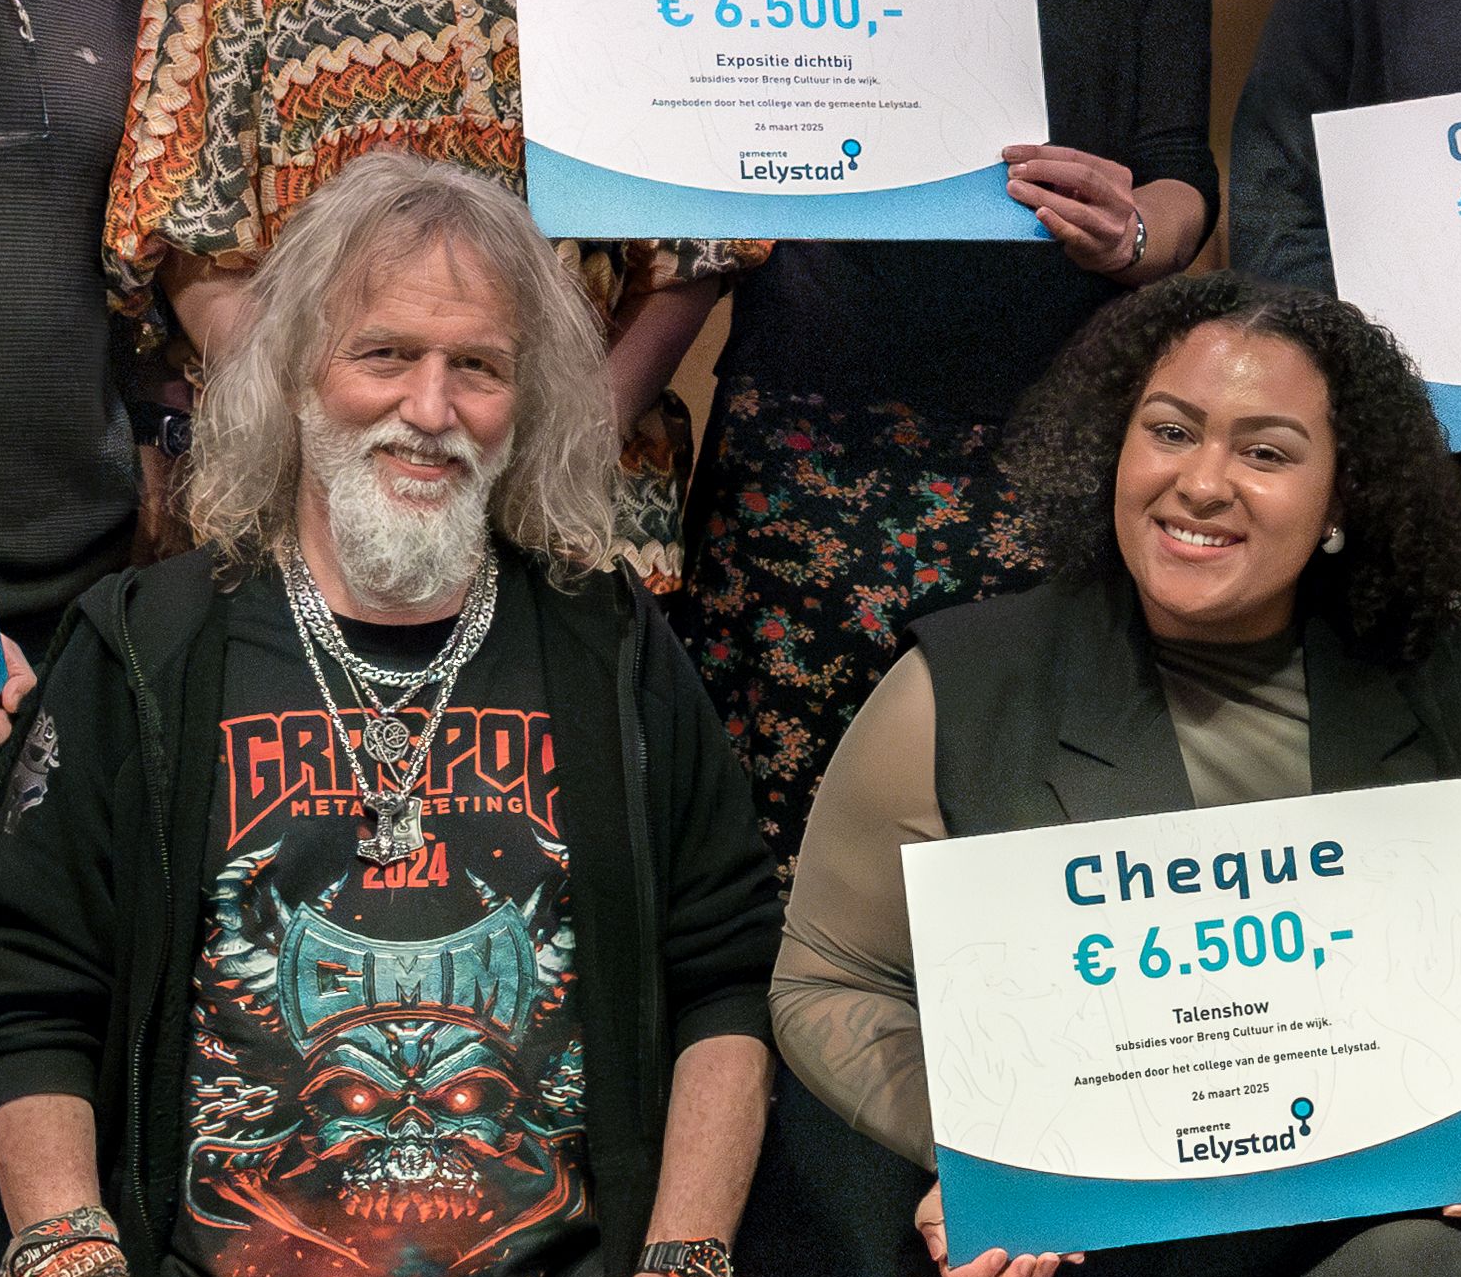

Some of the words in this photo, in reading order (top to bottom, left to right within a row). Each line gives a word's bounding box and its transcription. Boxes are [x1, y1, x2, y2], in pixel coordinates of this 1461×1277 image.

[716, 53, 790, 70] Expositie
[793, 54, 853, 72] dichtbij
[754, 122, 767, 132] 26
[768, 123, 799, 132] maart
[800, 122, 825, 132] 2025
[738, 150, 788, 160] gemeente
[739, 159, 845, 185] Lelystad
[291, 798, 364, 817] META
[420, 796, 524, 816] EETING
[1064, 840, 1345, 907] Cheque
[1071, 933, 1117, 987] €
[1138, 910, 1354, 980] 6.500,-
[1171, 1001, 1270, 1025] Talenshow
[1115, 1037, 1168, 1052] subsidies
[1168, 1034, 1195, 1045] voor
[1196, 1030, 1231, 1043] Breng
[1232, 1024, 1275, 1038] Cultuur
[1276, 1022, 1288, 1033] in
[1289, 1020, 1304, 1031] de
[1305, 1016, 1333, 1030] wijk.
[1073, 1070, 1143, 1087] Aangeboden
[1144, 1066, 1170, 1078] door
[1172, 1063, 1191, 1075] het
[1192, 1059, 1234, 1072] college
[1234, 1056, 1255, 1067] van
[1256, 1053, 1271, 1065] de
[1272, 1047, 1329, 1065] gemeente
[1330, 1039, 1381, 1056] Lelystad.
[1191, 1090, 1206, 1102] 26
[1207, 1086, 1242, 1100] maart
[1242, 1082, 1270, 1096] 2025
[1175, 1122, 1232, 1139] gemeente
[1176, 1124, 1296, 1164] Lelystad
